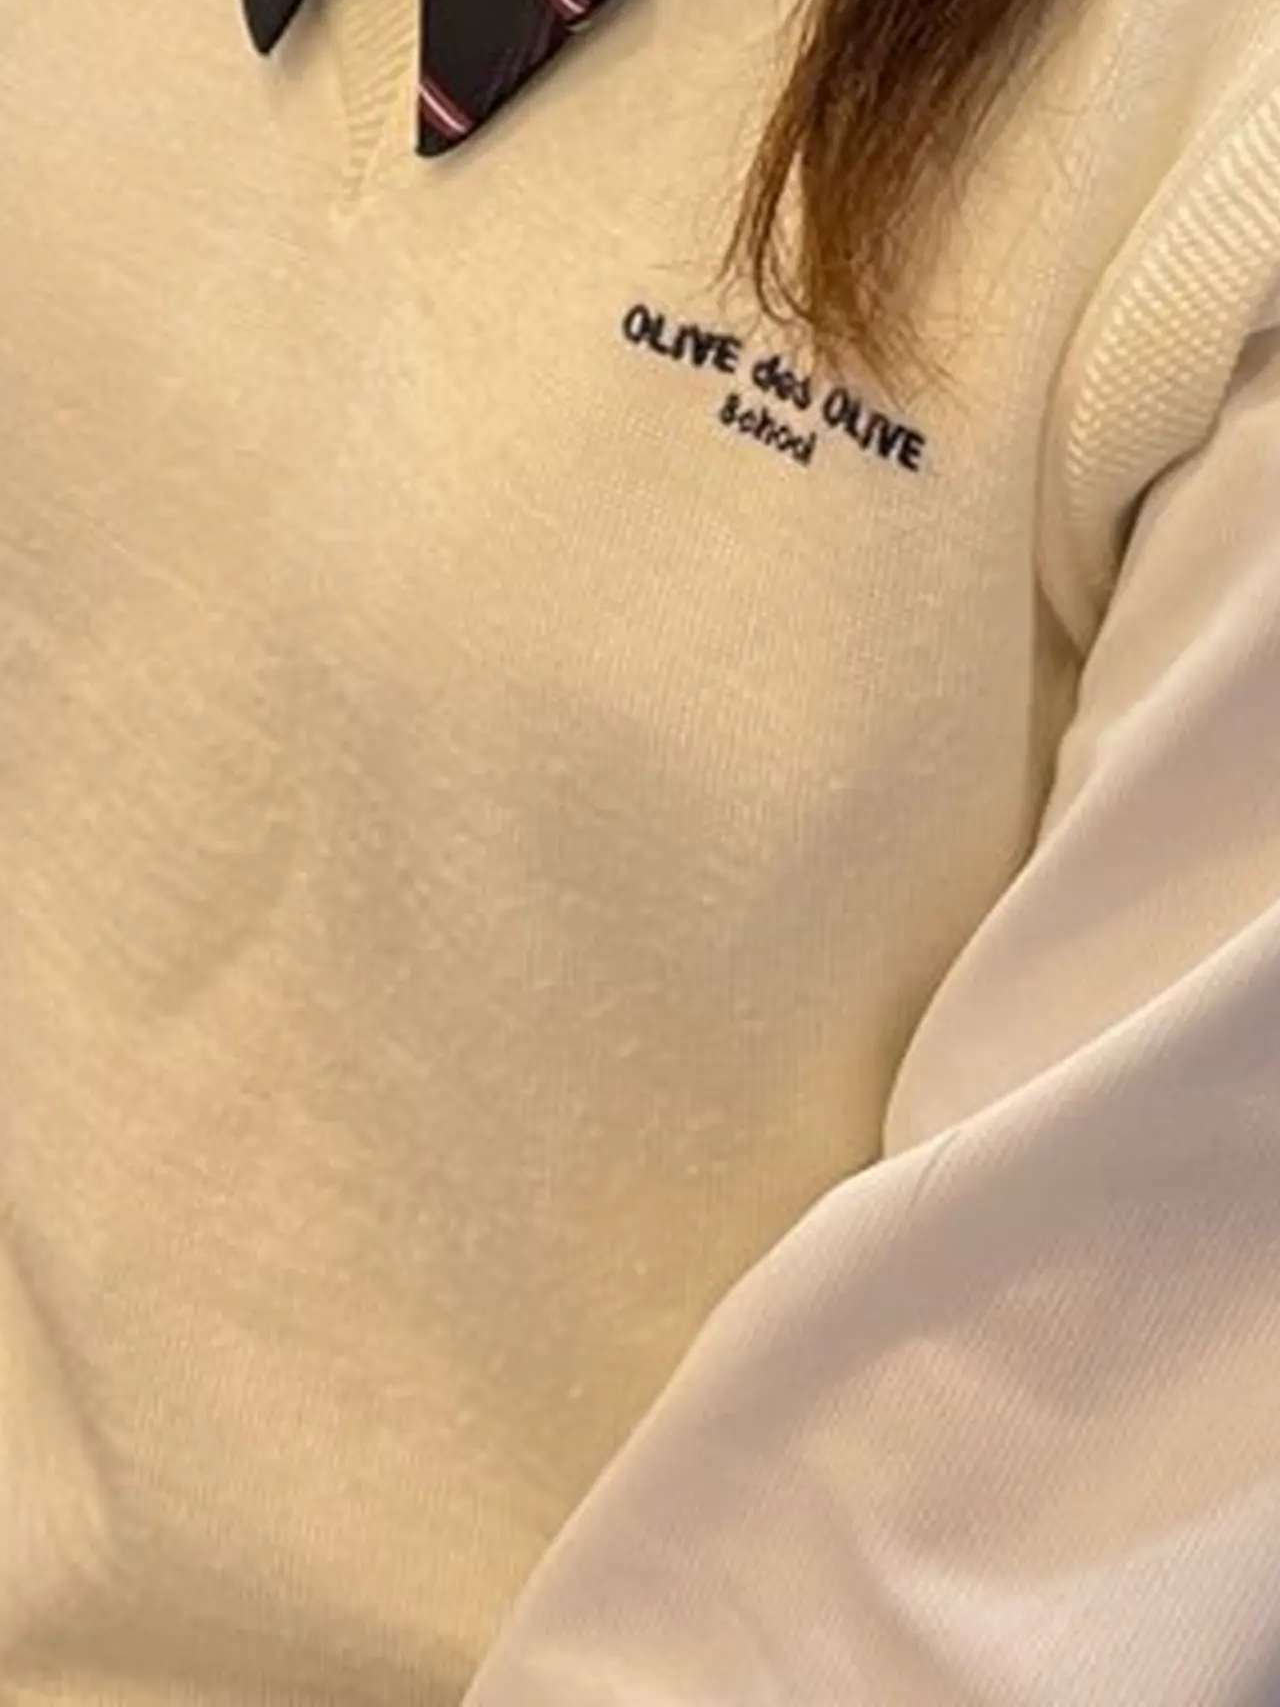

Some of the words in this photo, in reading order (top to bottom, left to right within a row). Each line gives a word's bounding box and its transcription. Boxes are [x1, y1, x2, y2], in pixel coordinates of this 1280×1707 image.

[623, 304, 742, 374] OLIVE
[751, 355, 813, 411] des
[822, 388, 925, 473] OLIVE
